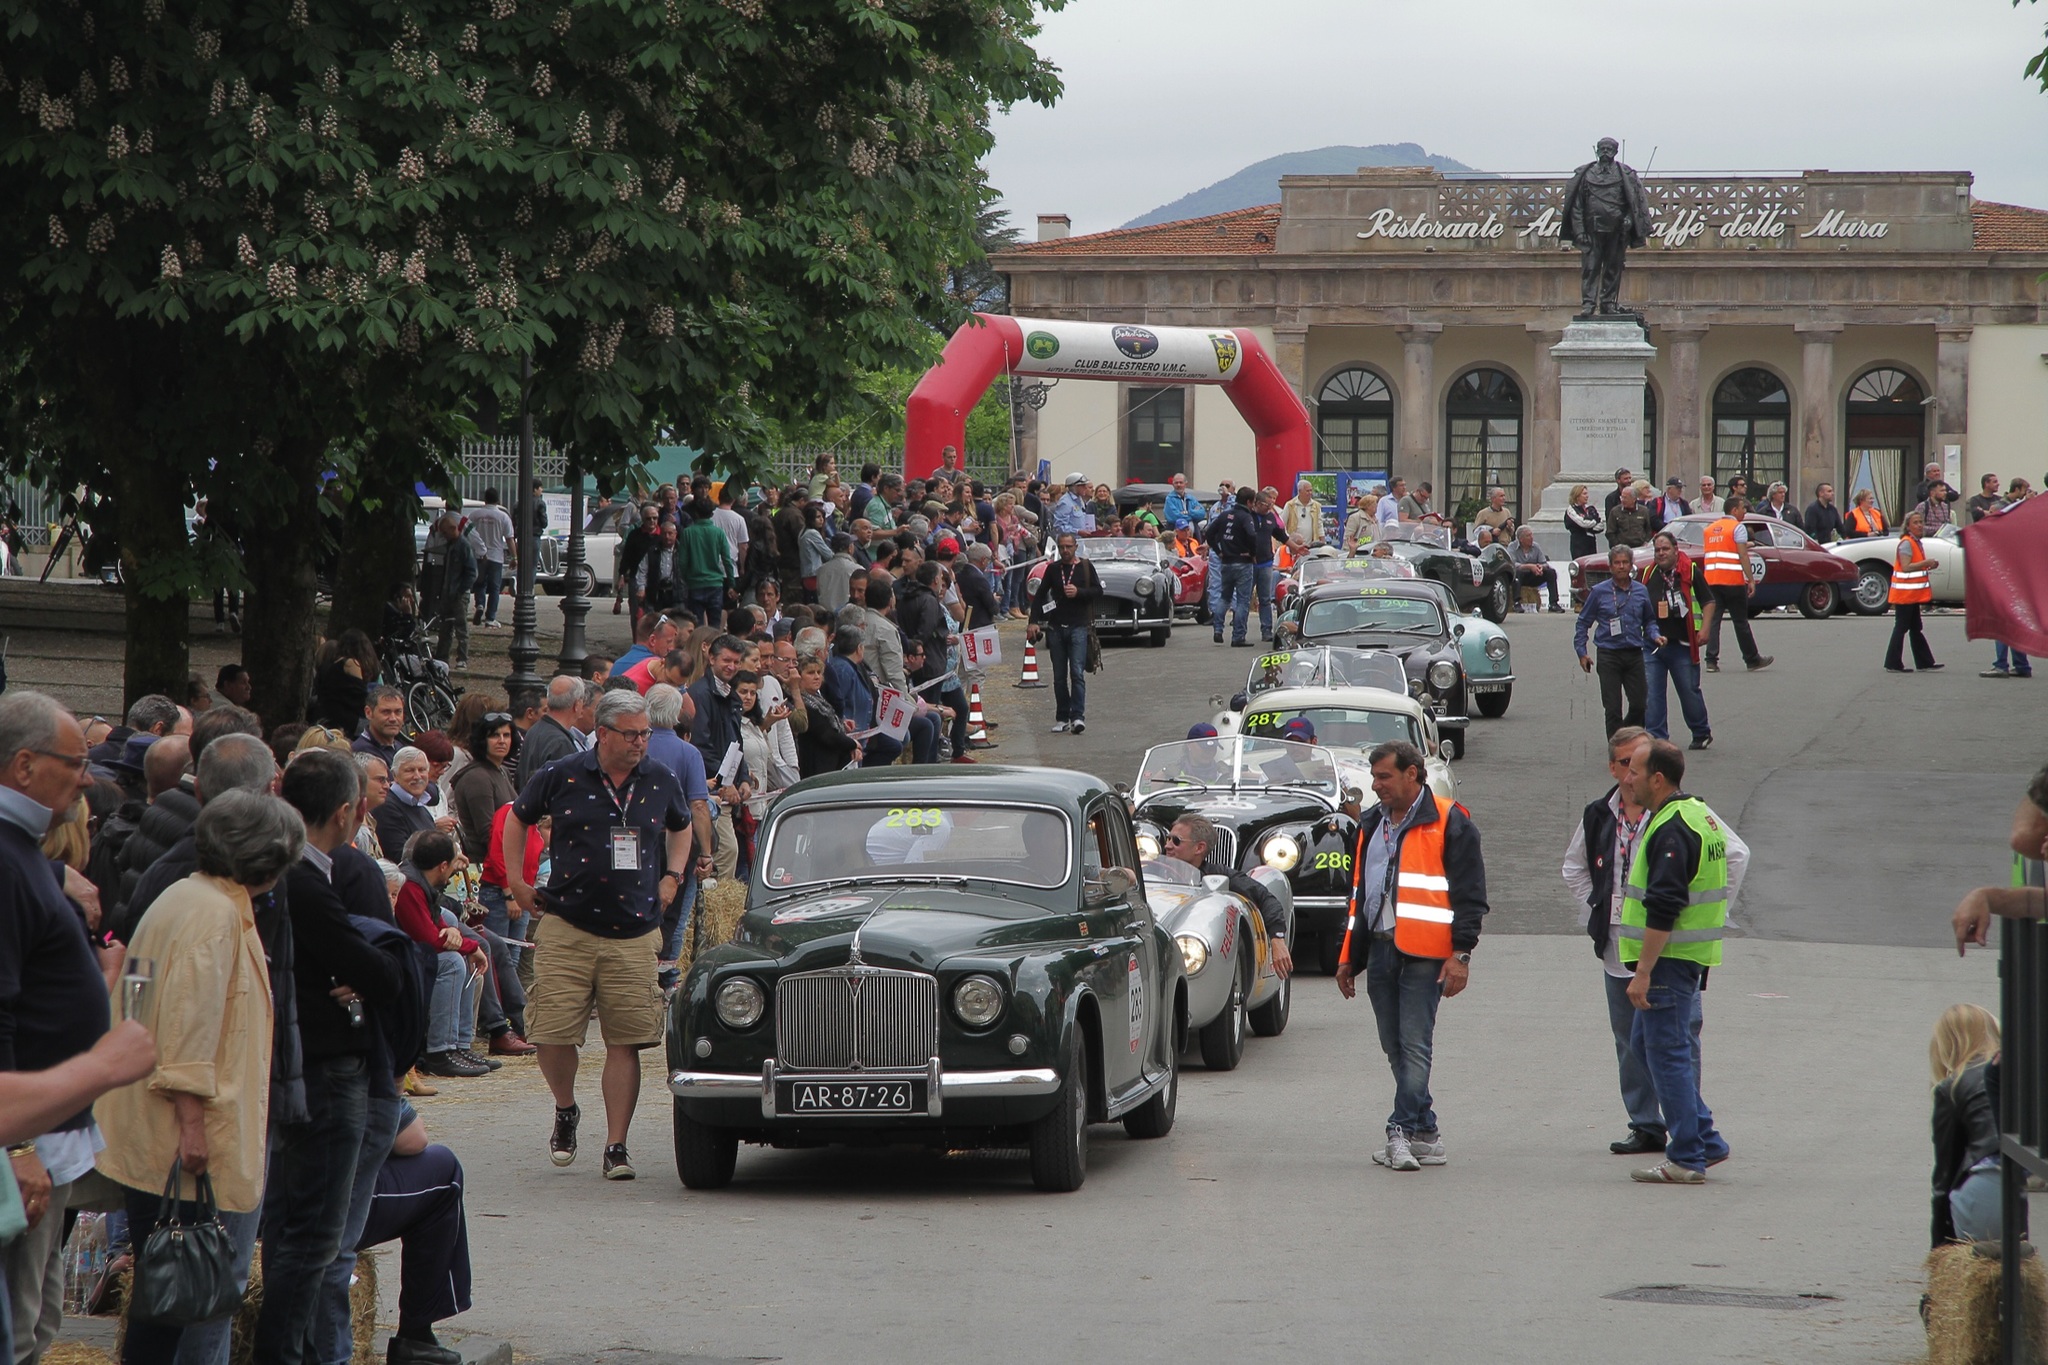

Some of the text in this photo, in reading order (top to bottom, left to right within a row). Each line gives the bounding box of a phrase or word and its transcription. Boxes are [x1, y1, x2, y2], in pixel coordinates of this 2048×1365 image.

[1357, 208, 1504, 239] Ristorante
[1648, 207, 1708, 247] affè
[1719, 209, 1785, 238] delle
[1801, 208, 1889, 238] Mura
[1074, 359, 1187, 373] CLUB BALESTRERO V.M.C.
[1345, 560, 1369, 569] 295
[1751, 563, 1763, 575] 02
[1360, 588, 1388, 596] 293
[1261, 652, 1291, 668] 289
[1248, 712, 1283, 728] 287
[886, 808, 942, 828] 283
[1315, 851, 1351, 871] 286
